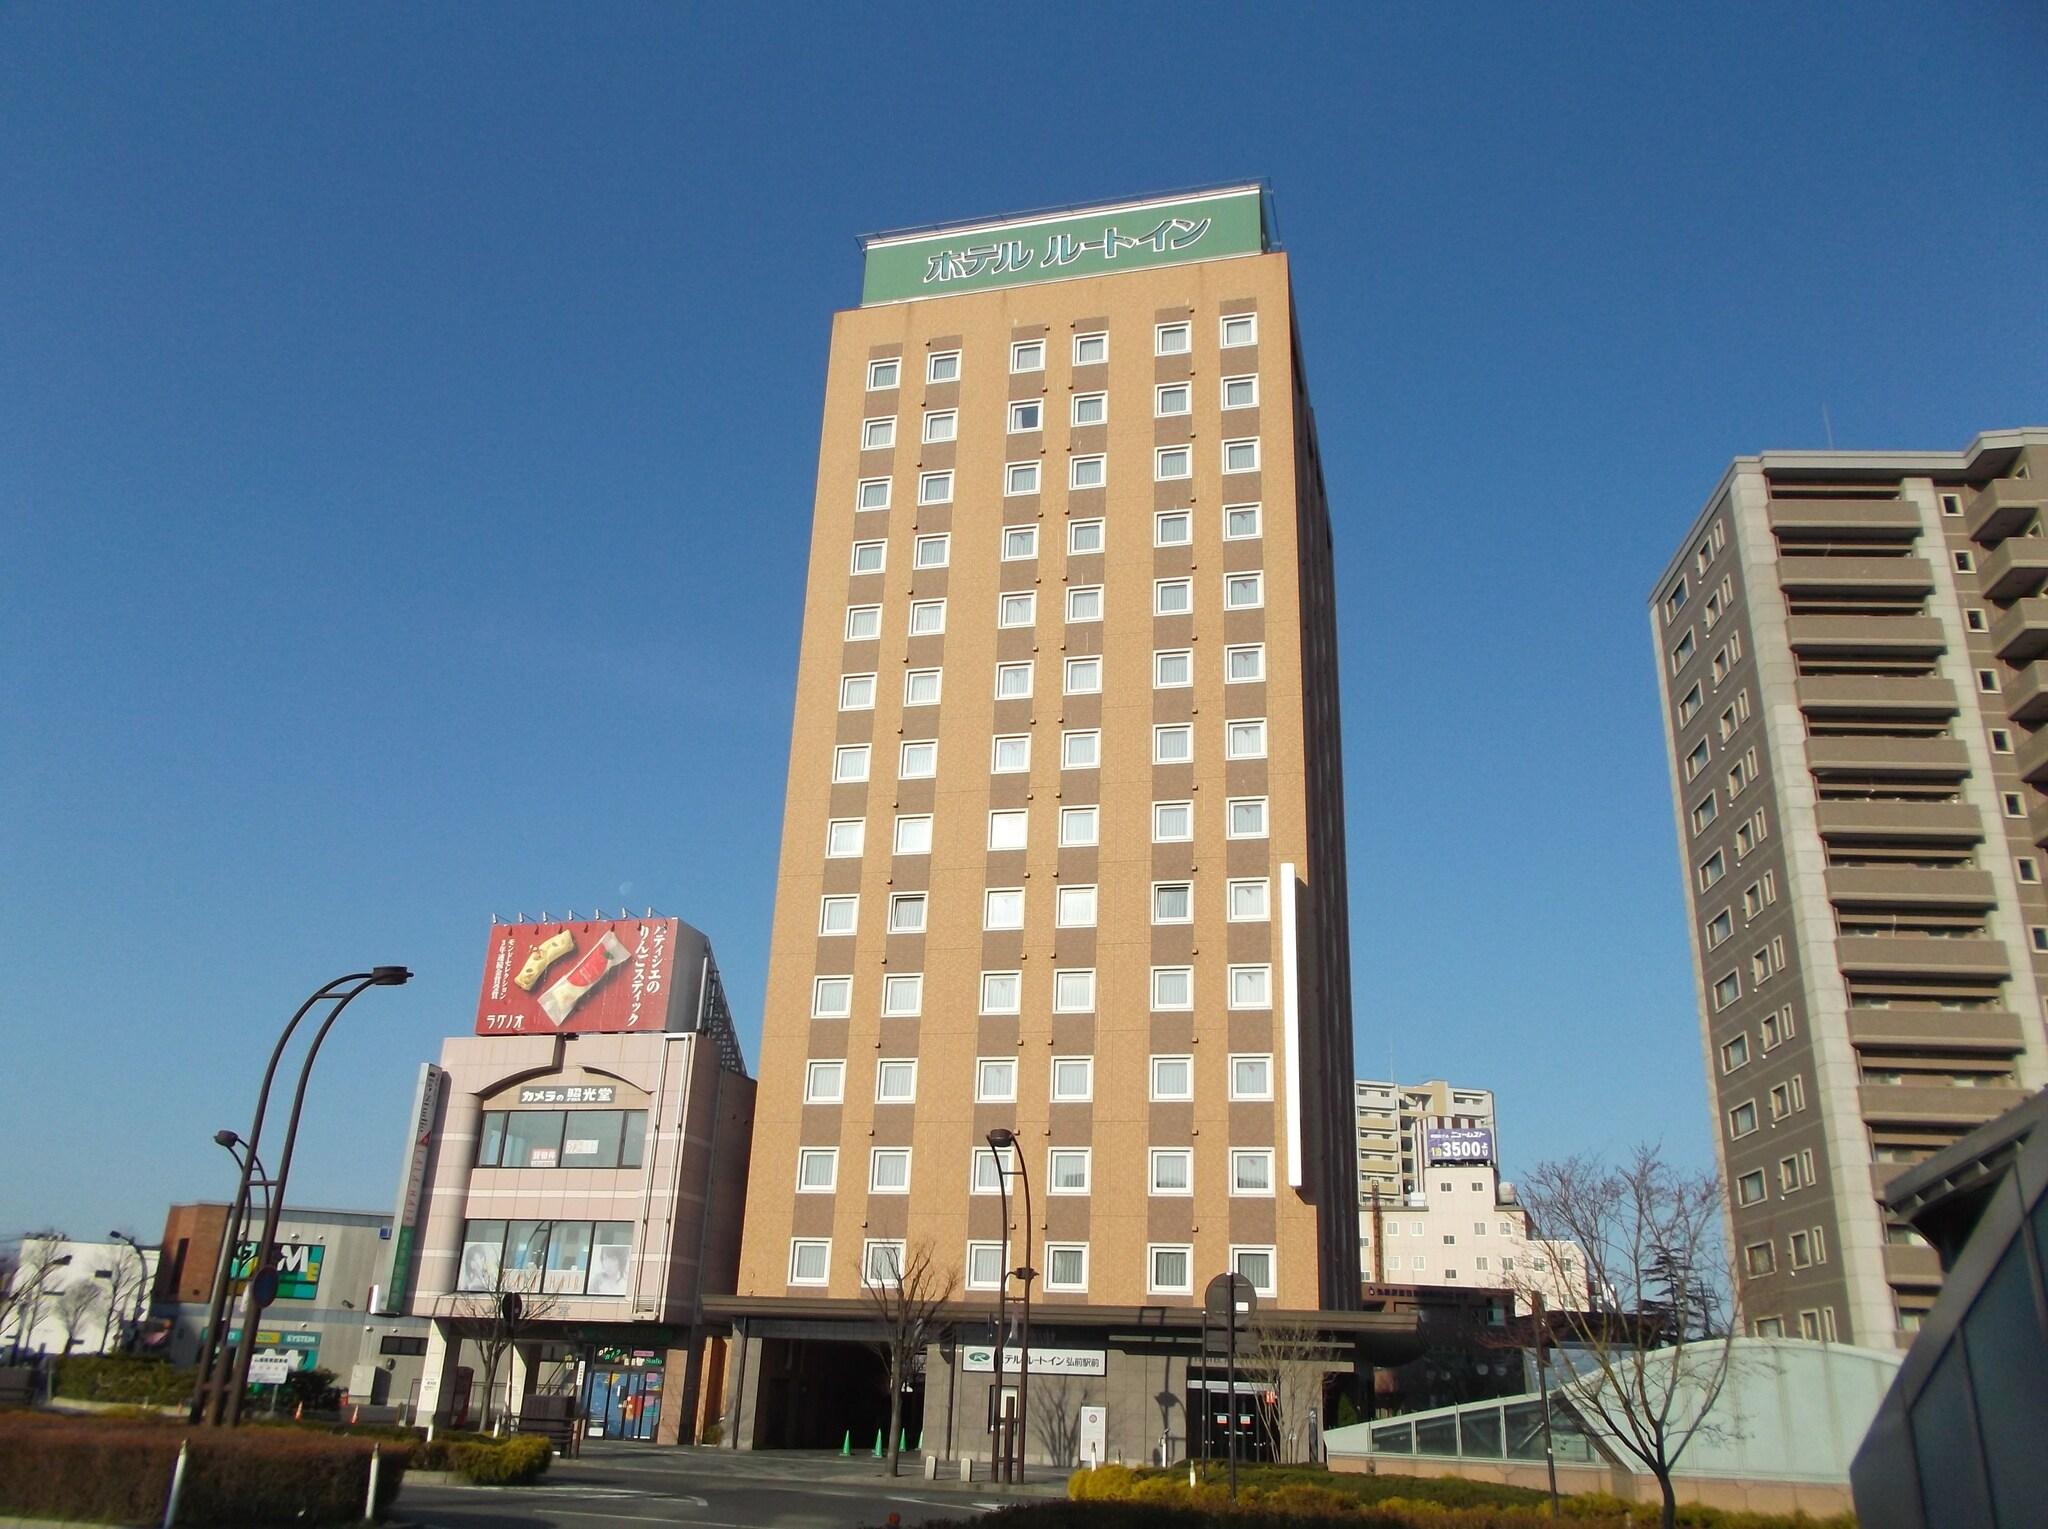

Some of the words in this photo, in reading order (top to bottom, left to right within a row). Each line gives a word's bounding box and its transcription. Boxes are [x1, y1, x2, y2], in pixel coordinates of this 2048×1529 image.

[923, 240, 1033, 283] ホテル
[1040, 217, 1213, 269] ルートイン
